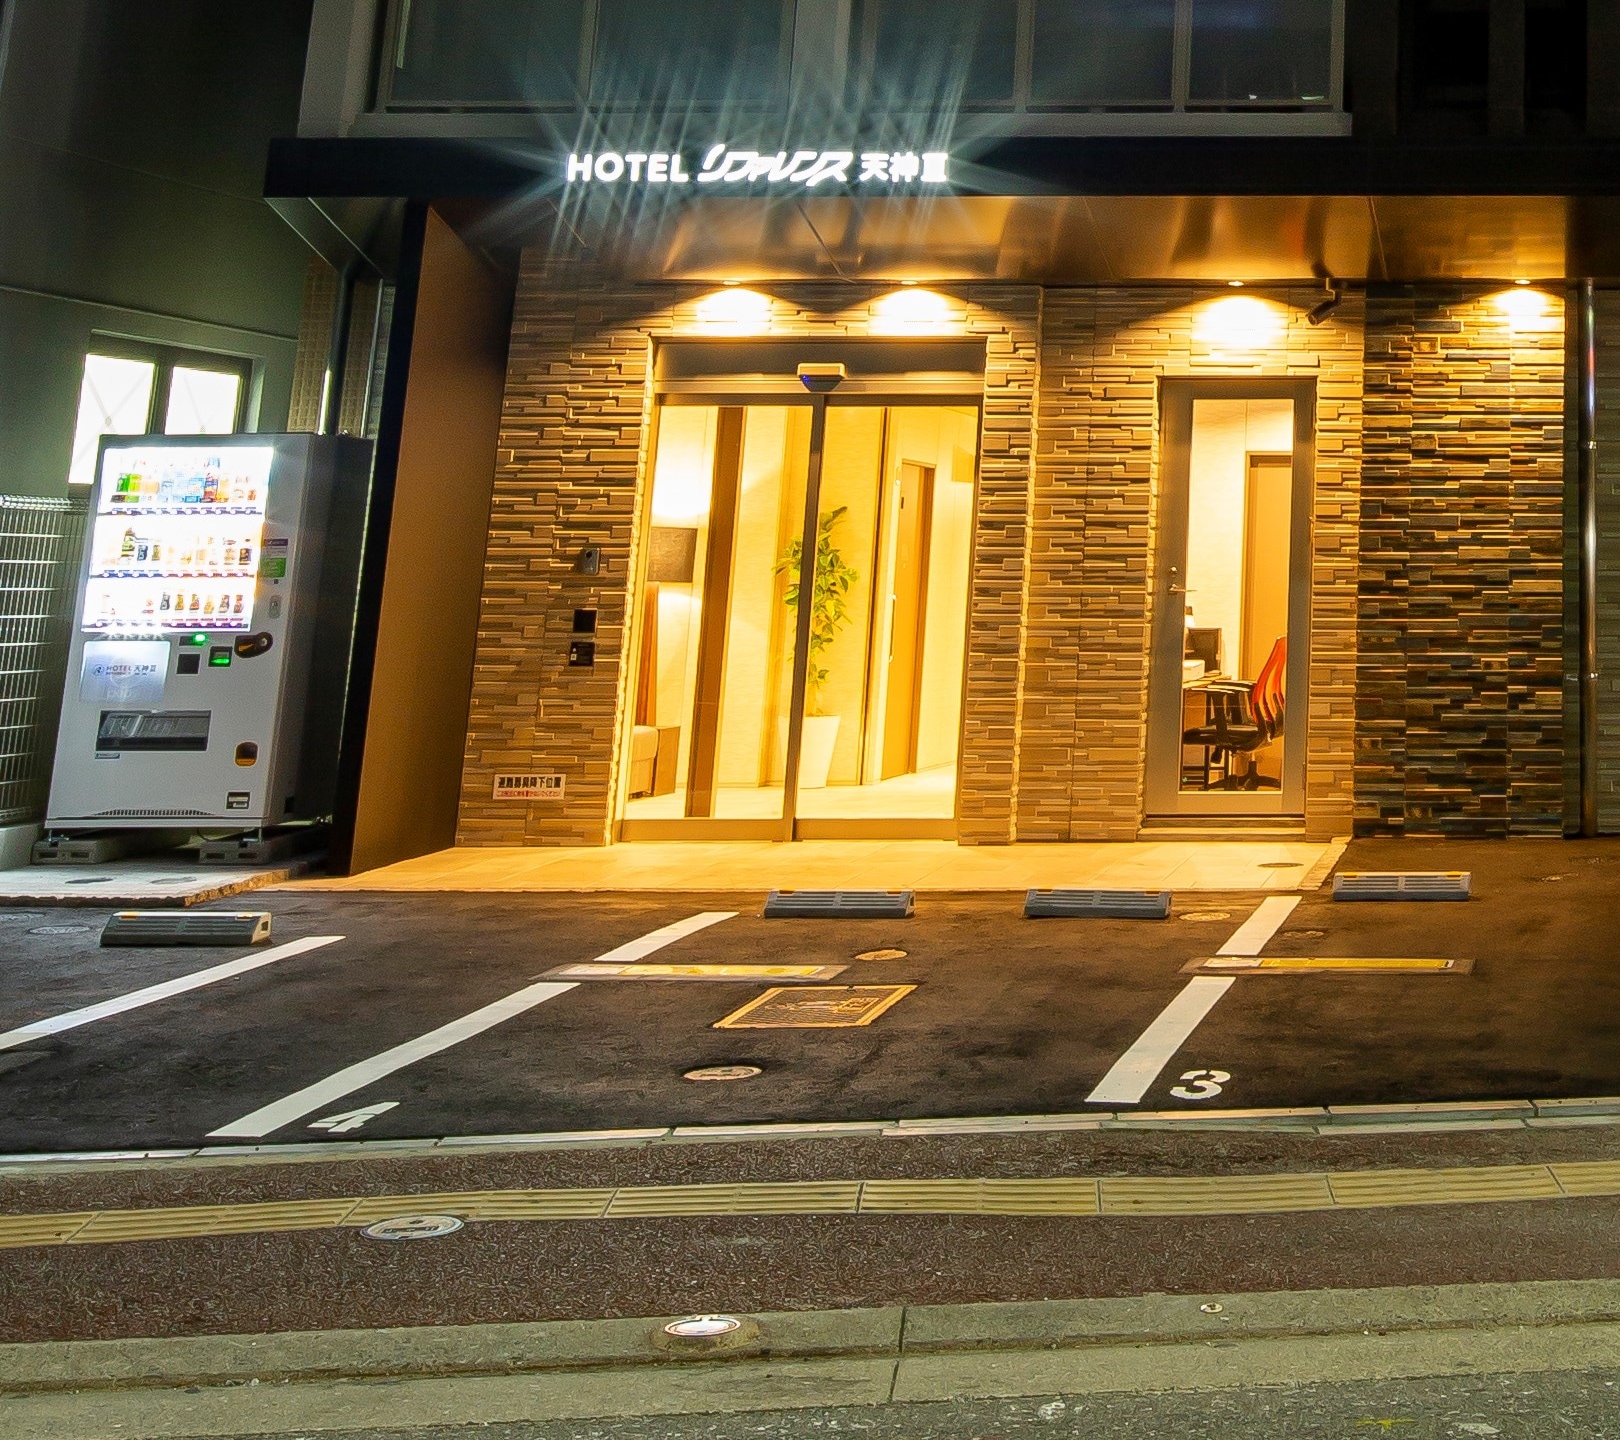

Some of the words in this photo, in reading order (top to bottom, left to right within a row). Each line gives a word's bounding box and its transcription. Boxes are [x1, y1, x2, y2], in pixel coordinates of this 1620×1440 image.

[567, 152, 689, 182] HOTEL
[1169, 1070, 1231, 1100] 3
[306, 1101, 400, 1133] 4
